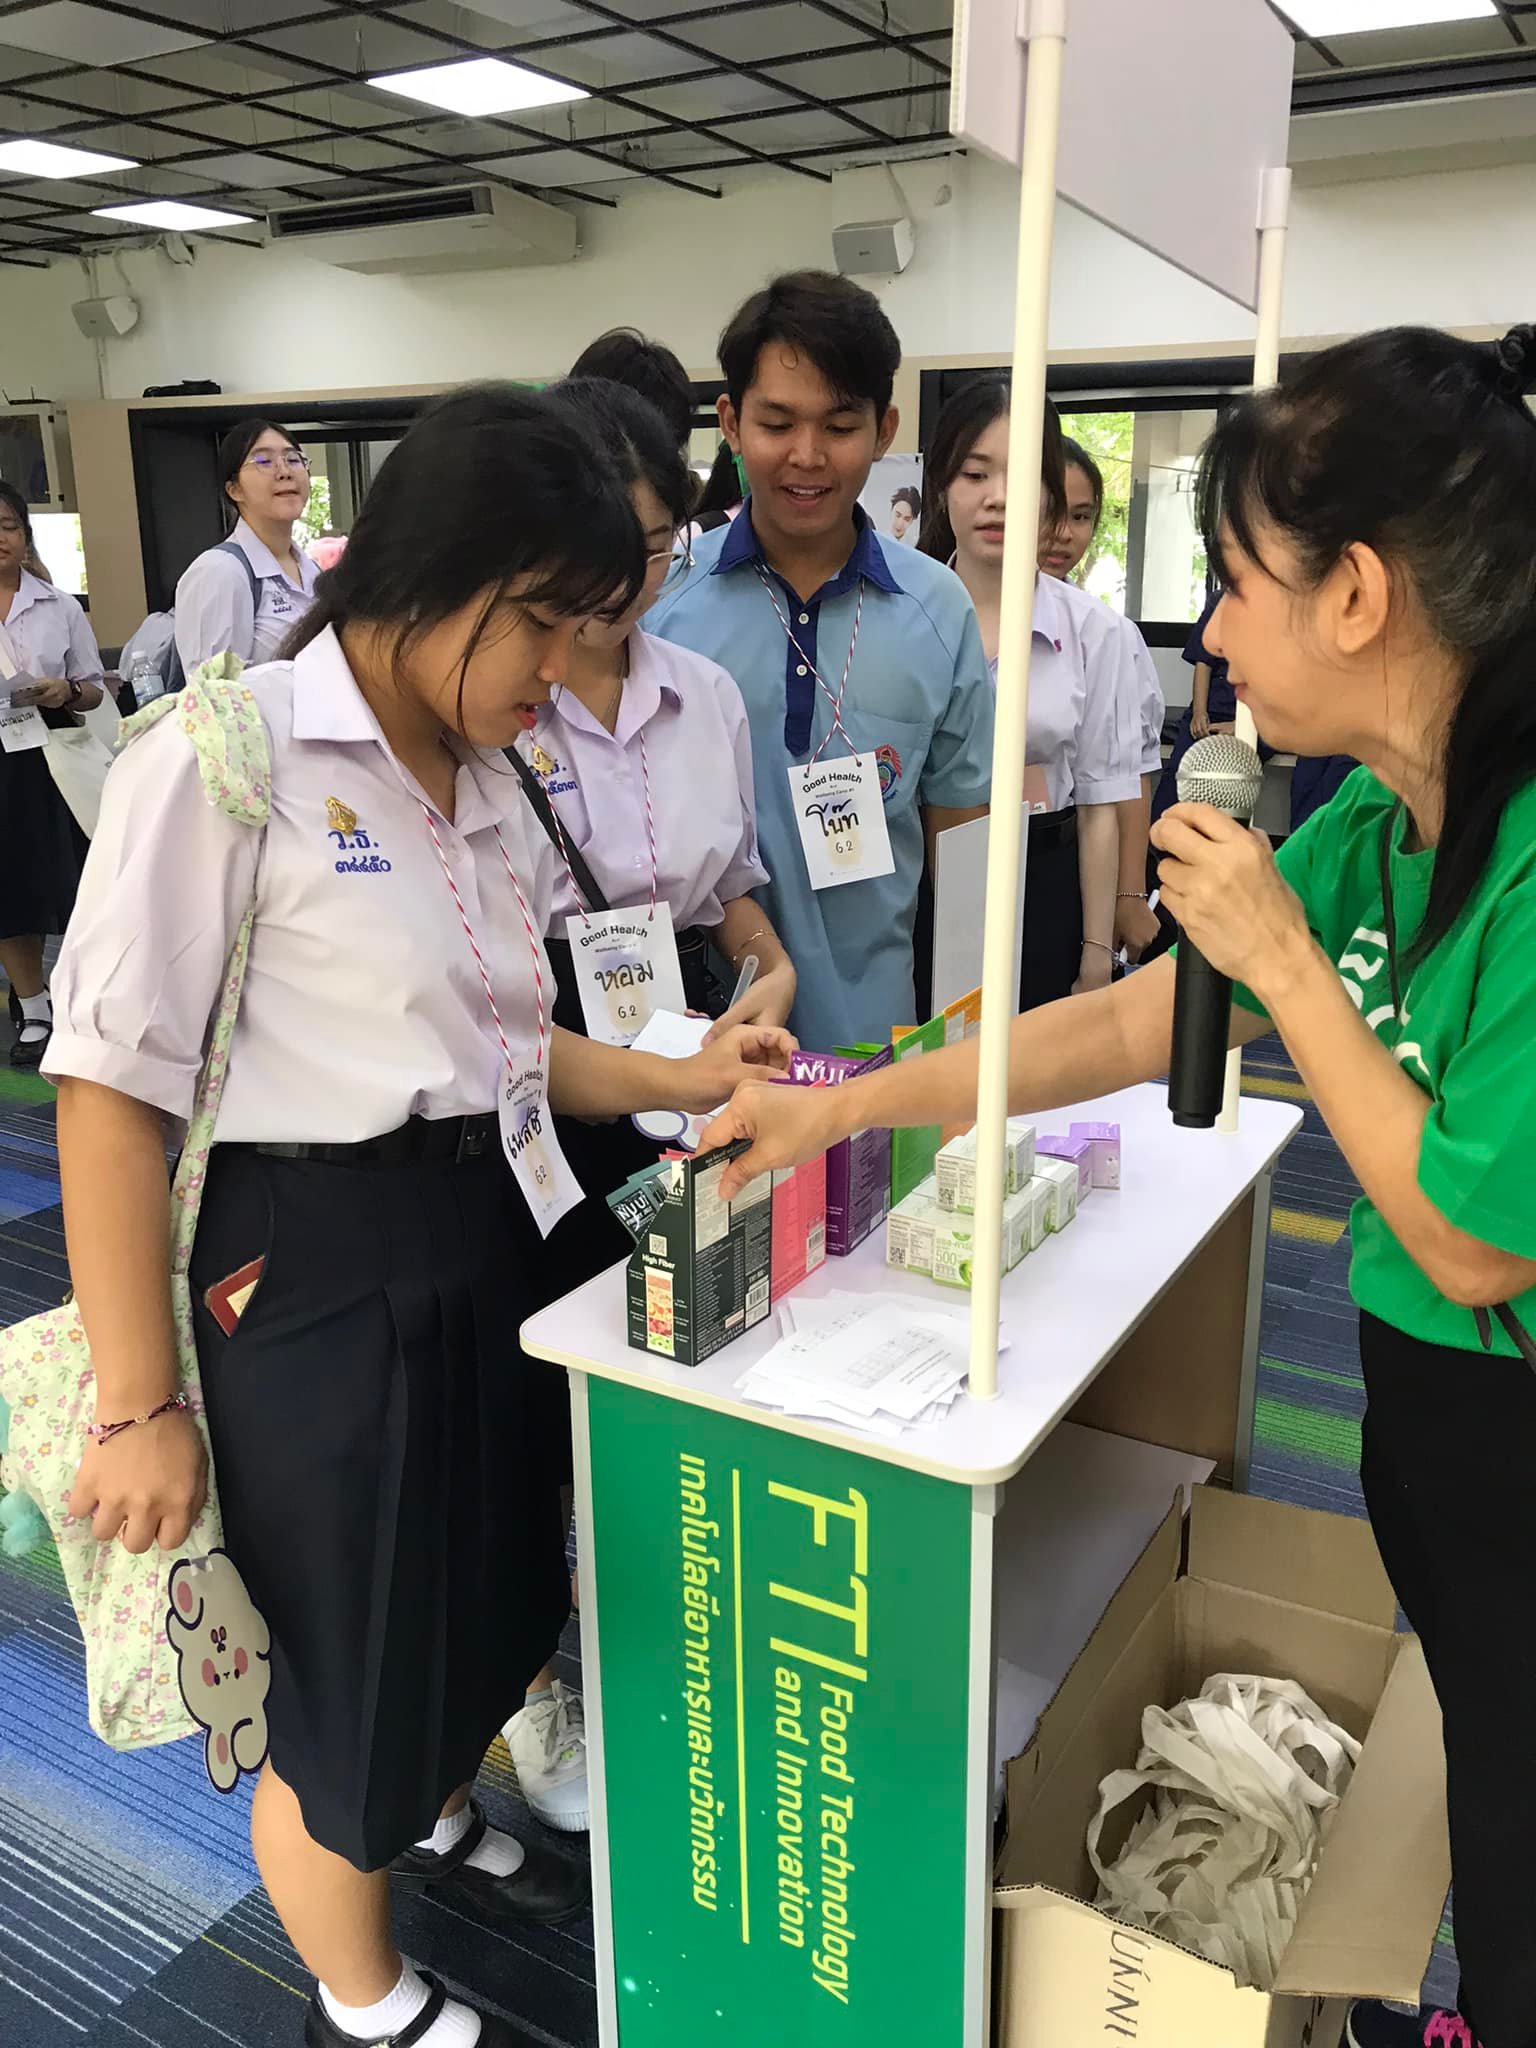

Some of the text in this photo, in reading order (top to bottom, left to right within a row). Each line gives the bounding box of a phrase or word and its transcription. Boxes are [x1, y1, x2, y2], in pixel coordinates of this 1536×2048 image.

[802, 772, 862, 794] Good Health
[580, 925, 648, 947] Good Health
[594, 960, 654, 992] หอม
[506, 1075, 524, 1100] Good
[768, 1480, 868, 1682] FTI
[680, 1453, 725, 1912] เทคโนโลยีอาหารและนวัตกรรม
[775, 1665, 813, 1949] and Innovation
[812, 1682, 856, 2005] Food Technology
